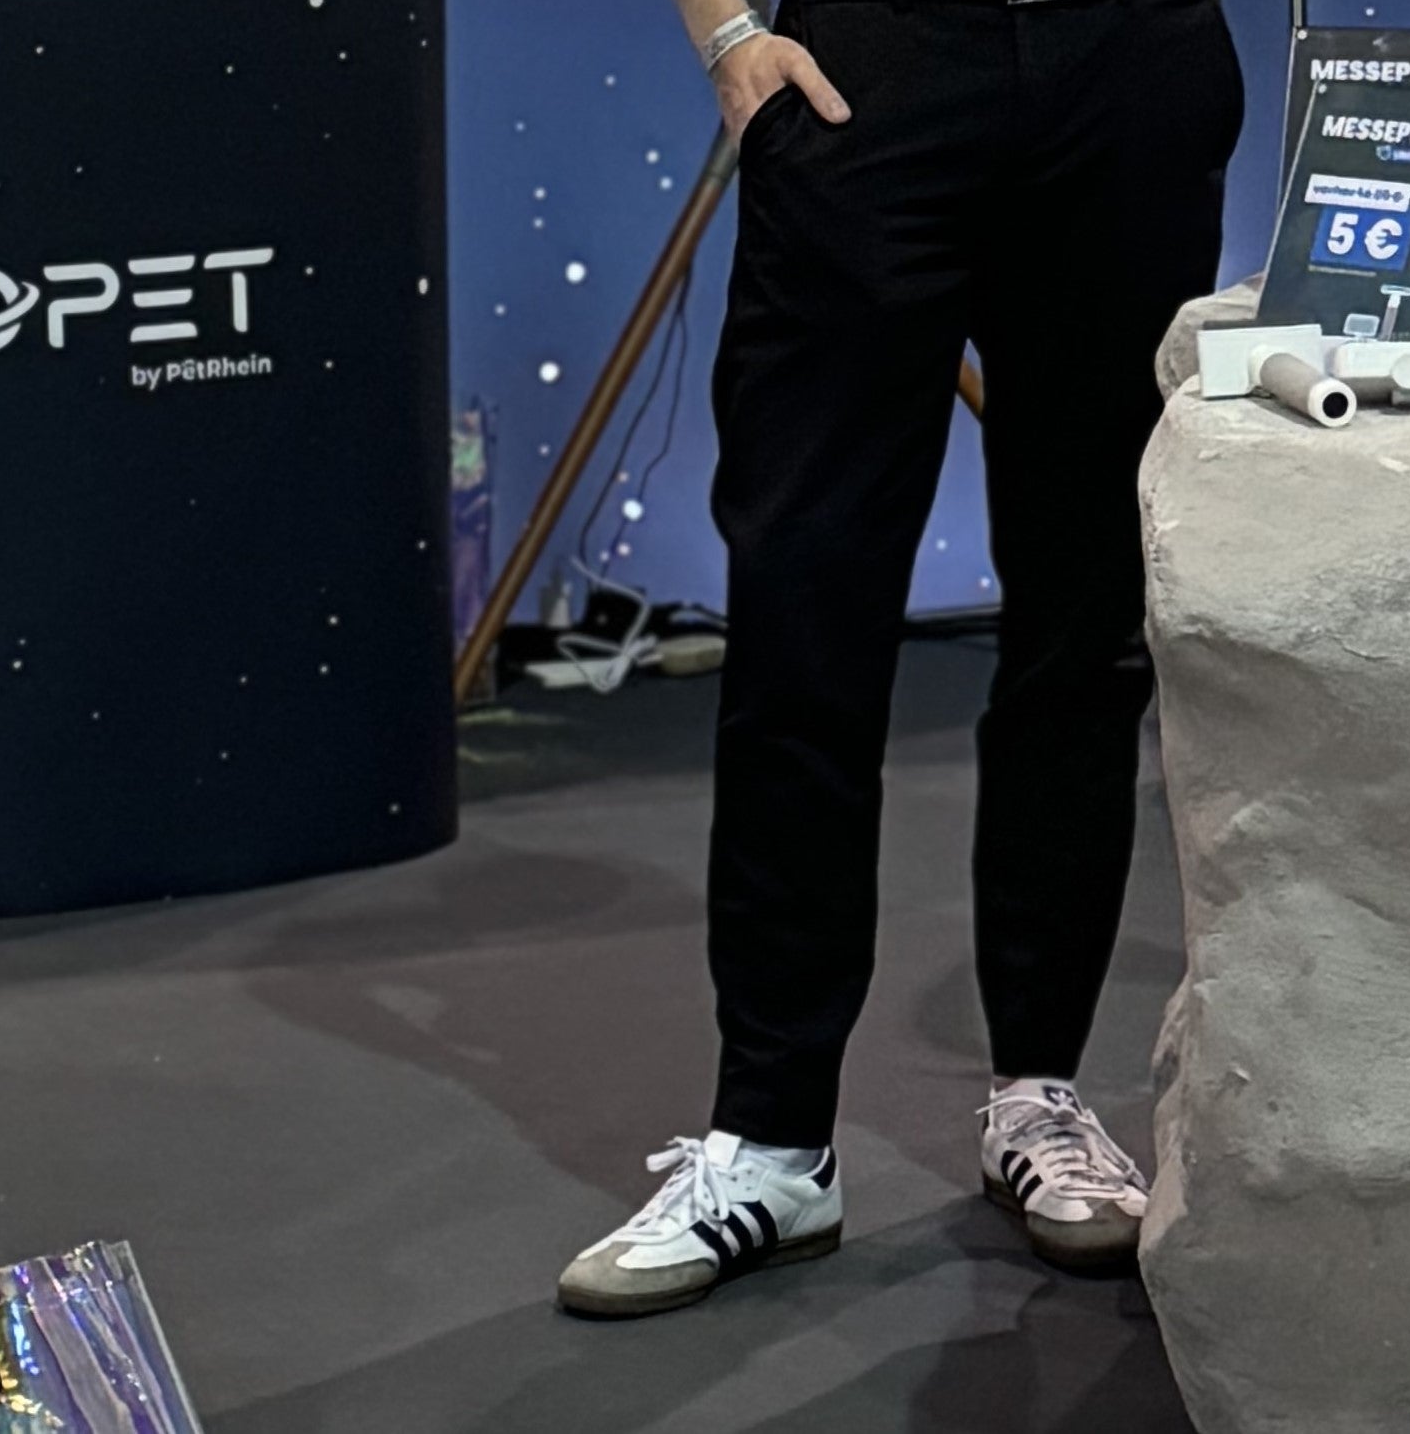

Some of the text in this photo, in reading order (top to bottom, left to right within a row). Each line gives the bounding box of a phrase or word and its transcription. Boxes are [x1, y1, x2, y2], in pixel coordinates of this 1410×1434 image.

[1327, 212, 1403, 260] 5 €
[131, 365, 162, 392] by
